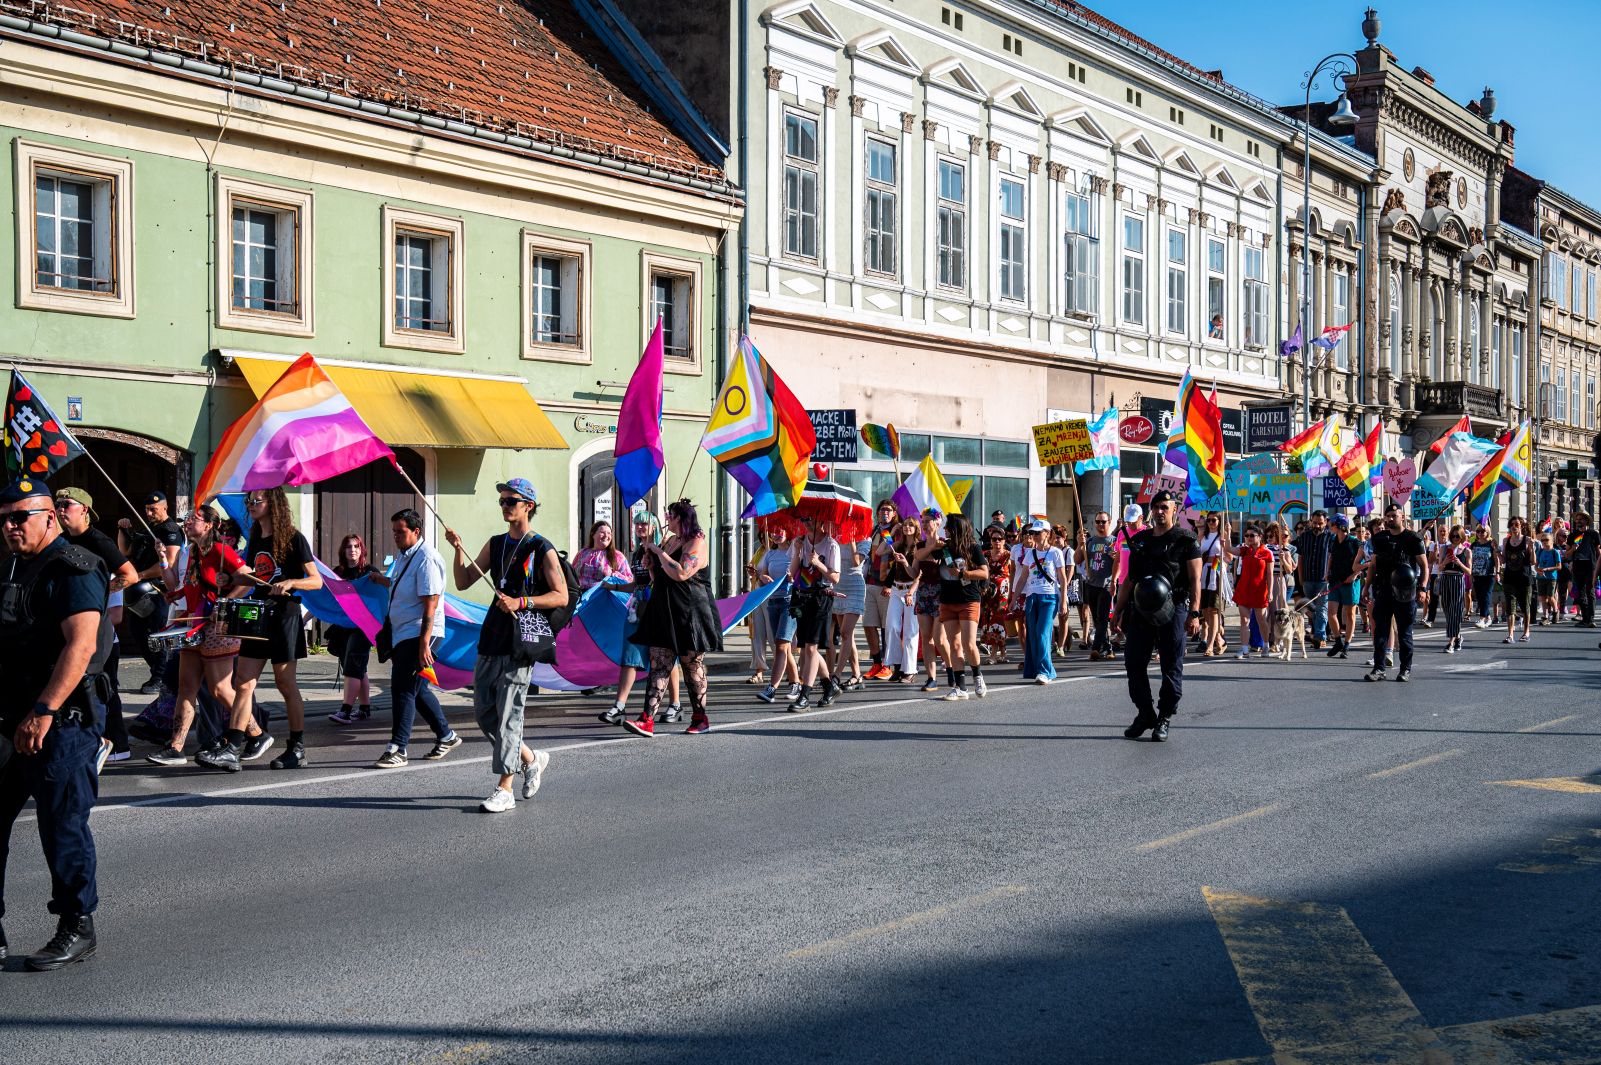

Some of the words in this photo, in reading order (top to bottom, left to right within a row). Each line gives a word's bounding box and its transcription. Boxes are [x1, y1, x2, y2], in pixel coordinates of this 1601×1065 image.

[843, 411, 847, 424] I
[1252, 411, 1287, 424] HOTEL
[1251, 425, 1287, 436] CARLSTADT
[1161, 478, 1175, 489] TU
[1252, 491, 1271, 503] NA
